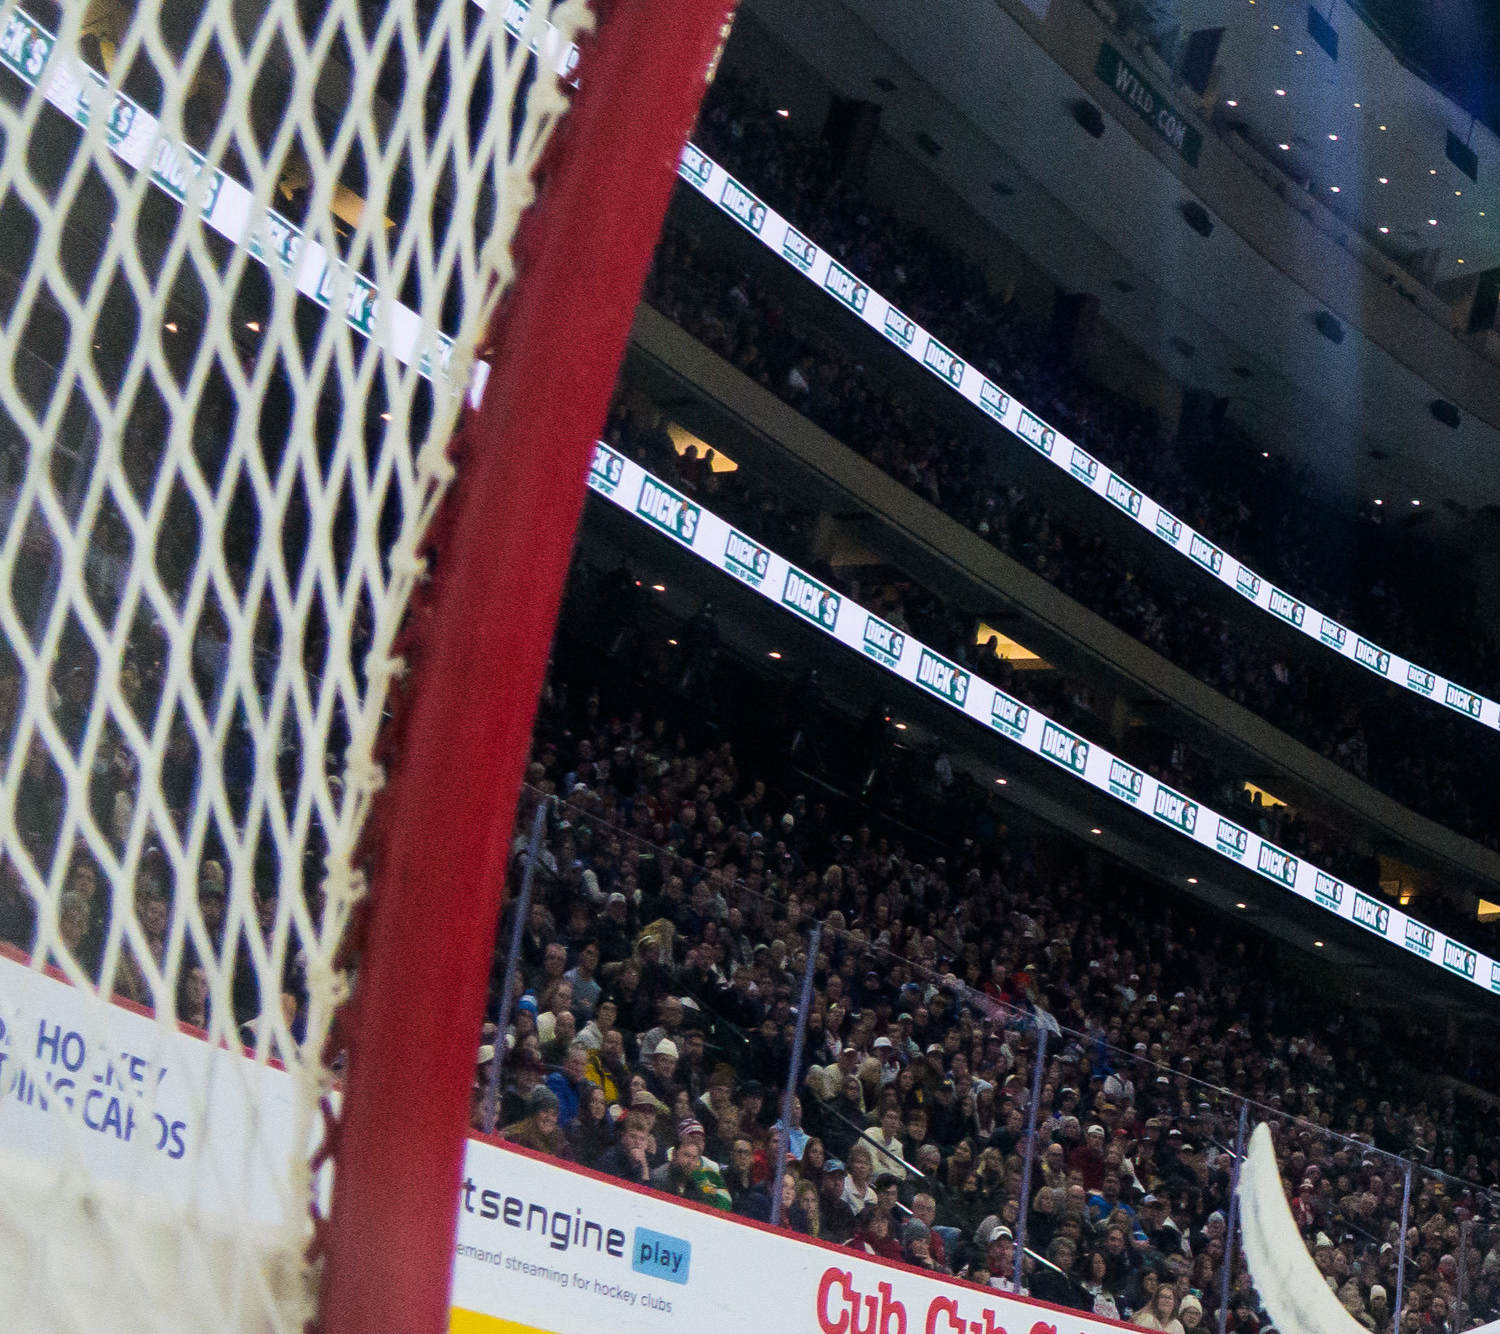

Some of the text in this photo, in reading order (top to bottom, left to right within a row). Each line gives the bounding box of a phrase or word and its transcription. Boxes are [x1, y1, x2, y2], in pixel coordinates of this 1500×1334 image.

[725, 181, 766, 229] DICK'S
[926, 341, 964, 383] DICK'S
[641, 478, 698, 542] DICK'S
[1108, 475, 1141, 515] DICK'S
[727, 532, 769, 577] DICK'S
[1191, 536, 1222, 573] DICK'S
[785, 570, 839, 629] DICK'S
[866, 618, 903, 658] DICK'S
[1356, 640, 1390, 673] DICK'S
[920, 650, 968, 705] DICK'S
[994, 693, 1027, 731] DICK'S
[1447, 685, 1481, 717] DICK'S
[1155, 788, 1197, 832] DICK'S
[1260, 844, 1298, 884] DICK'S
[1355, 895, 1389, 933] DICK'S
[461, 1178, 684, 1275] tsengine play
[505, 1256, 569, 1288] streaming
[573, 1272, 591, 1290] for
[594, 1279, 638, 1306] hockey
